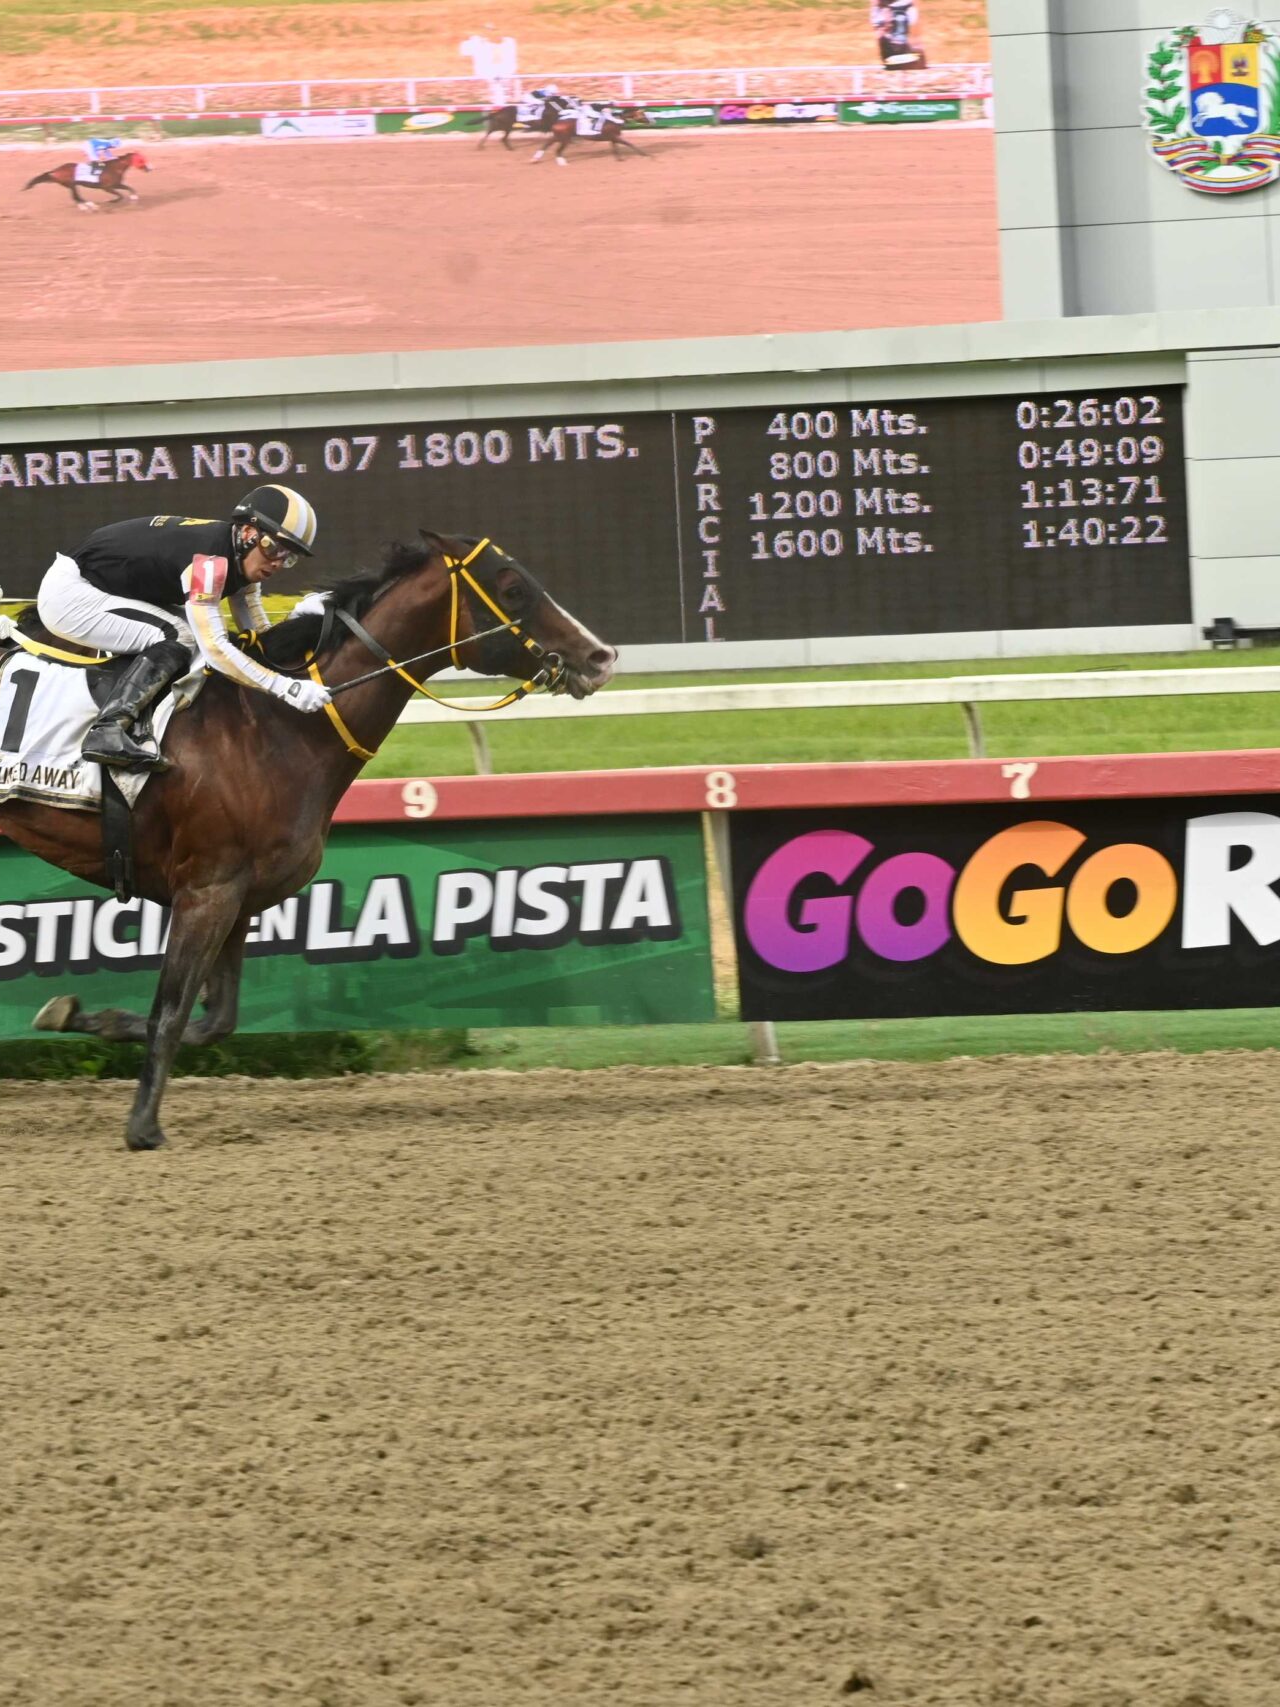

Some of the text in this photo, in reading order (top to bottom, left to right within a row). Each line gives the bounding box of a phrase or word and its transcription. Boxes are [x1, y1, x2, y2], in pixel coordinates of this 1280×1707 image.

[766, 396, 1164, 440] 400 Mts. 0:26:02
[192, 440, 307, 478] NRO.
[324, 435, 379, 471] 07
[398, 430, 512, 468] 1800
[528, 424, 639, 461] MTS.
[770, 435, 1165, 480] 800 Mts. 0:49:09
[749, 475, 1167, 520] 1200 Mts. 1:13:71
[750, 515, 1169, 560] 1600 Mts. 1:40:22
[202, 560, 215, 595] 1
[0, 668, 40, 754] 1
[31, 765, 80, 790] AWAY
[401, 780, 438, 818] 9
[704, 771, 738, 808] 8
[1001, 762, 1039, 799] 7
[305, 876, 411, 951] LA
[433, 859, 672, 942] PISTA
